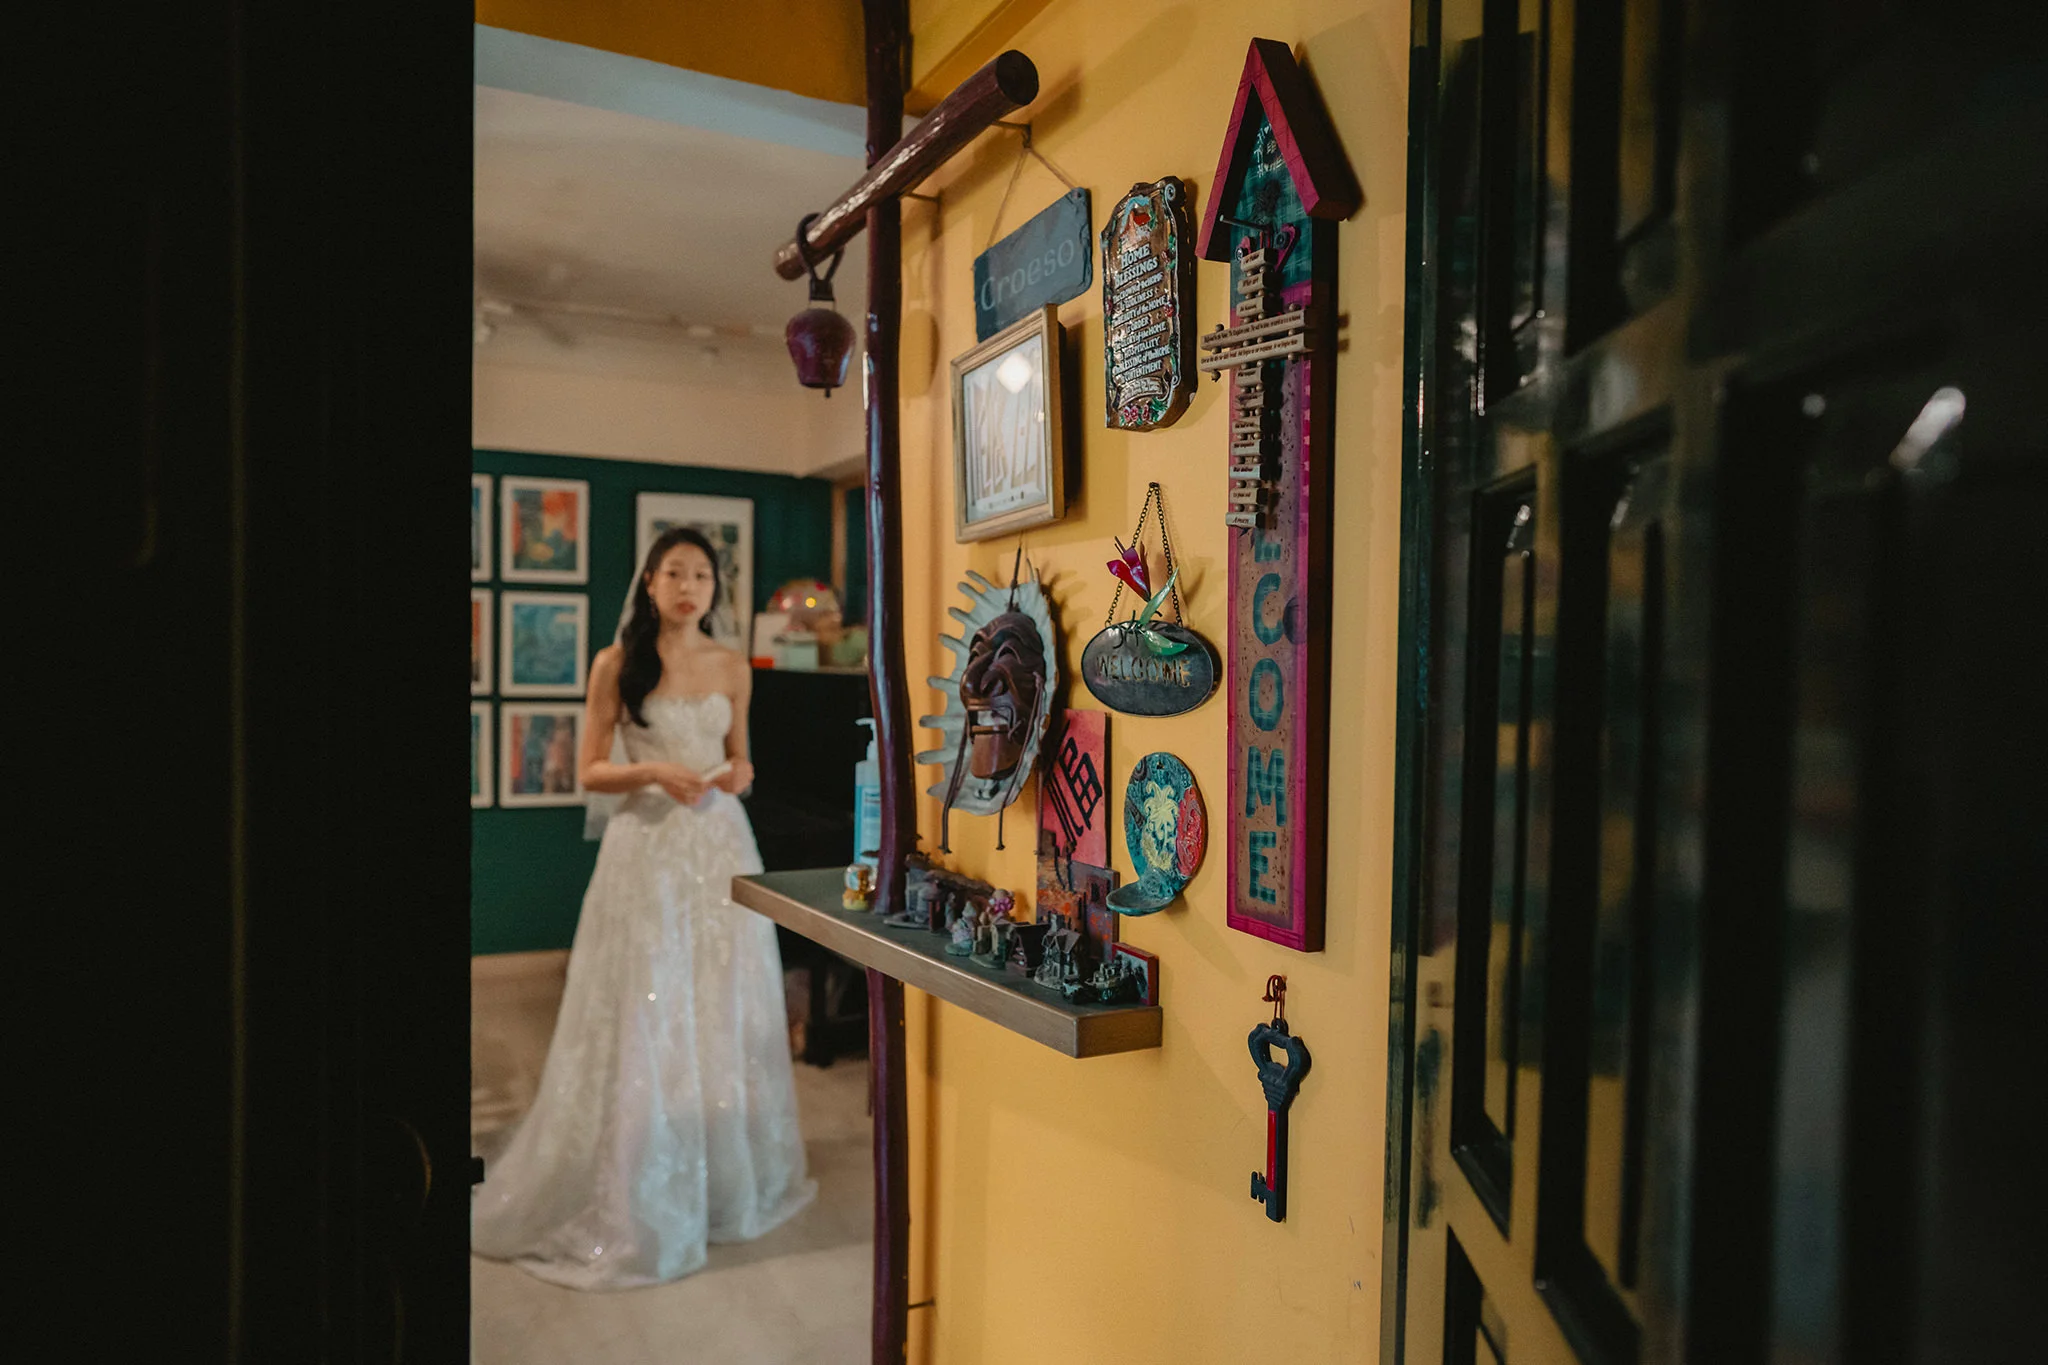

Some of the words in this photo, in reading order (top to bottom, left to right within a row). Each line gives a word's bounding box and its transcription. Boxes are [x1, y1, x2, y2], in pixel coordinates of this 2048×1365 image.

[1121, 243, 1151, 269] HOME
[981, 239, 1074, 311] Croeso
[1114, 257, 1158, 288] BLESSINGS
[1096, 654, 1191, 688] WELCOME
